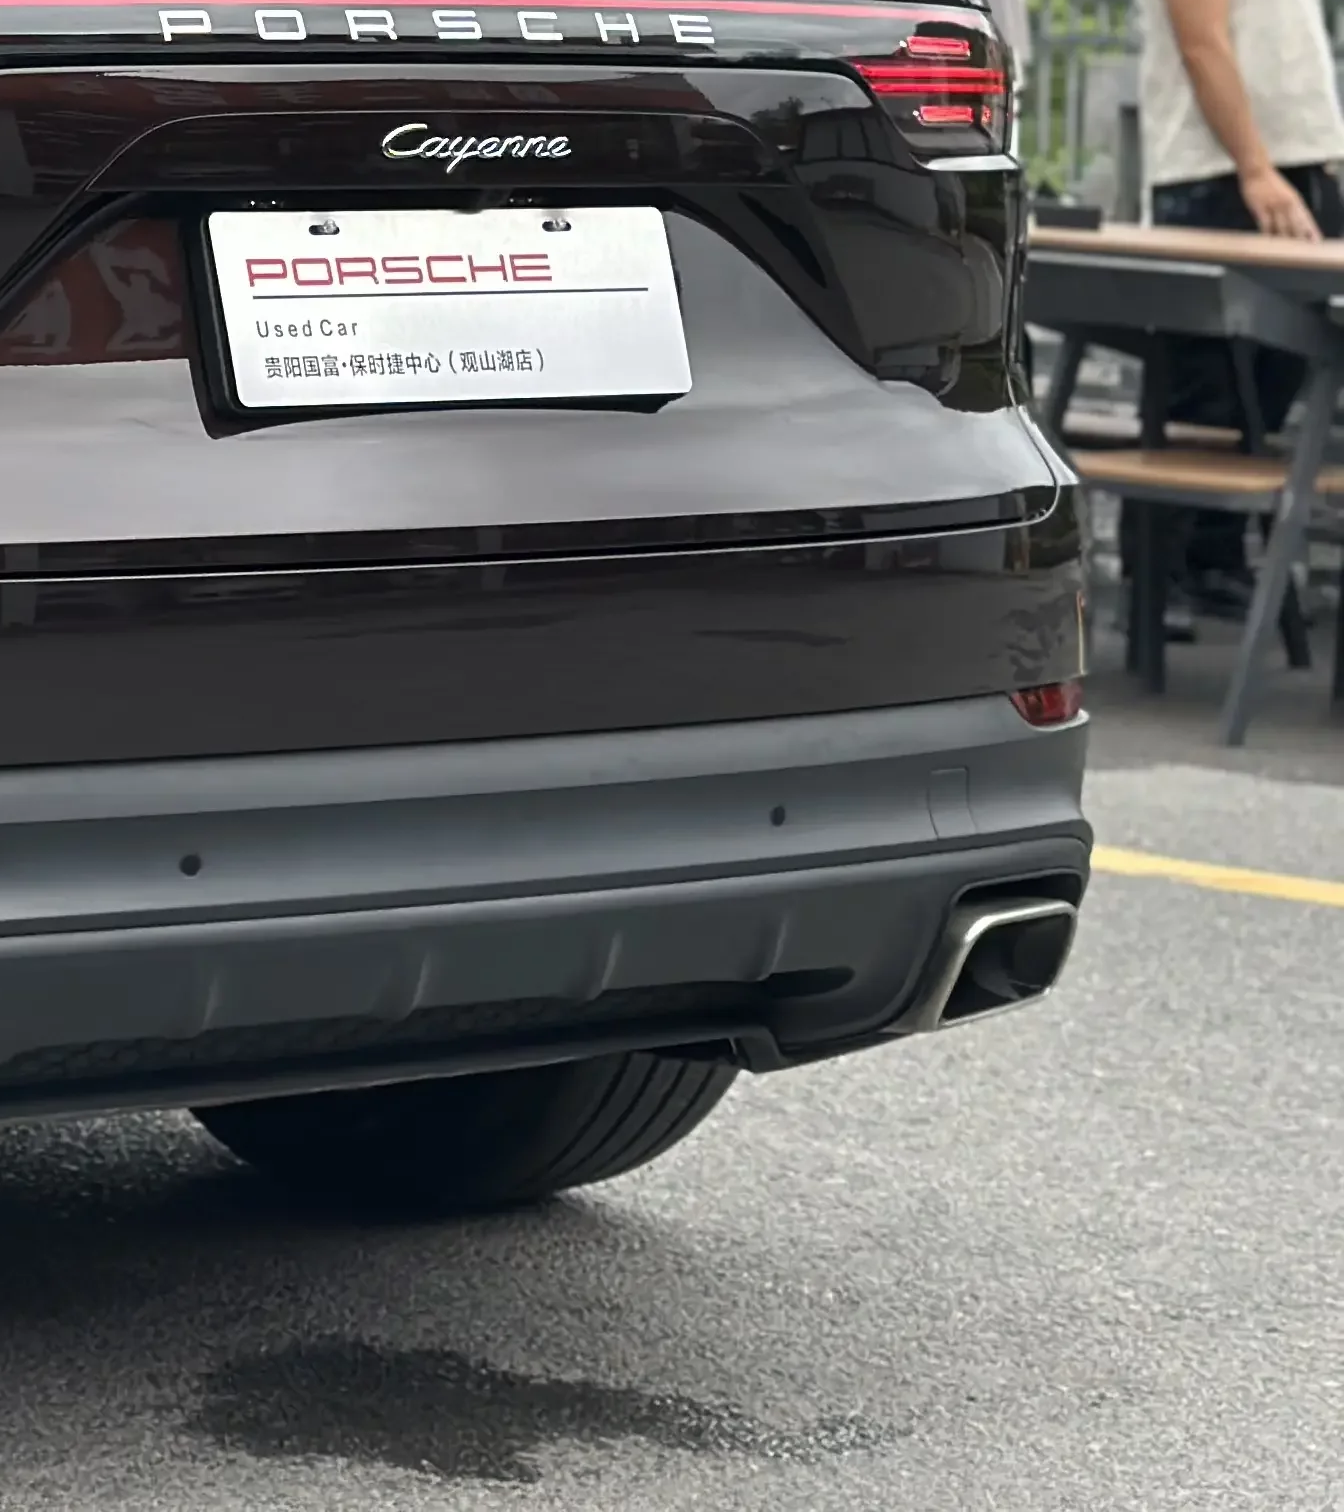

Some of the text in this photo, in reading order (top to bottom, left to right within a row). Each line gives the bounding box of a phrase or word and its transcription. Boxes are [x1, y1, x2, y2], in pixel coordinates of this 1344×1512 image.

[158, 8, 715, 44] PORSCHE
[381, 123, 572, 174] Cayenne
[246, 253, 552, 287] PORSCHE
[256, 318, 359, 338] Used Car
